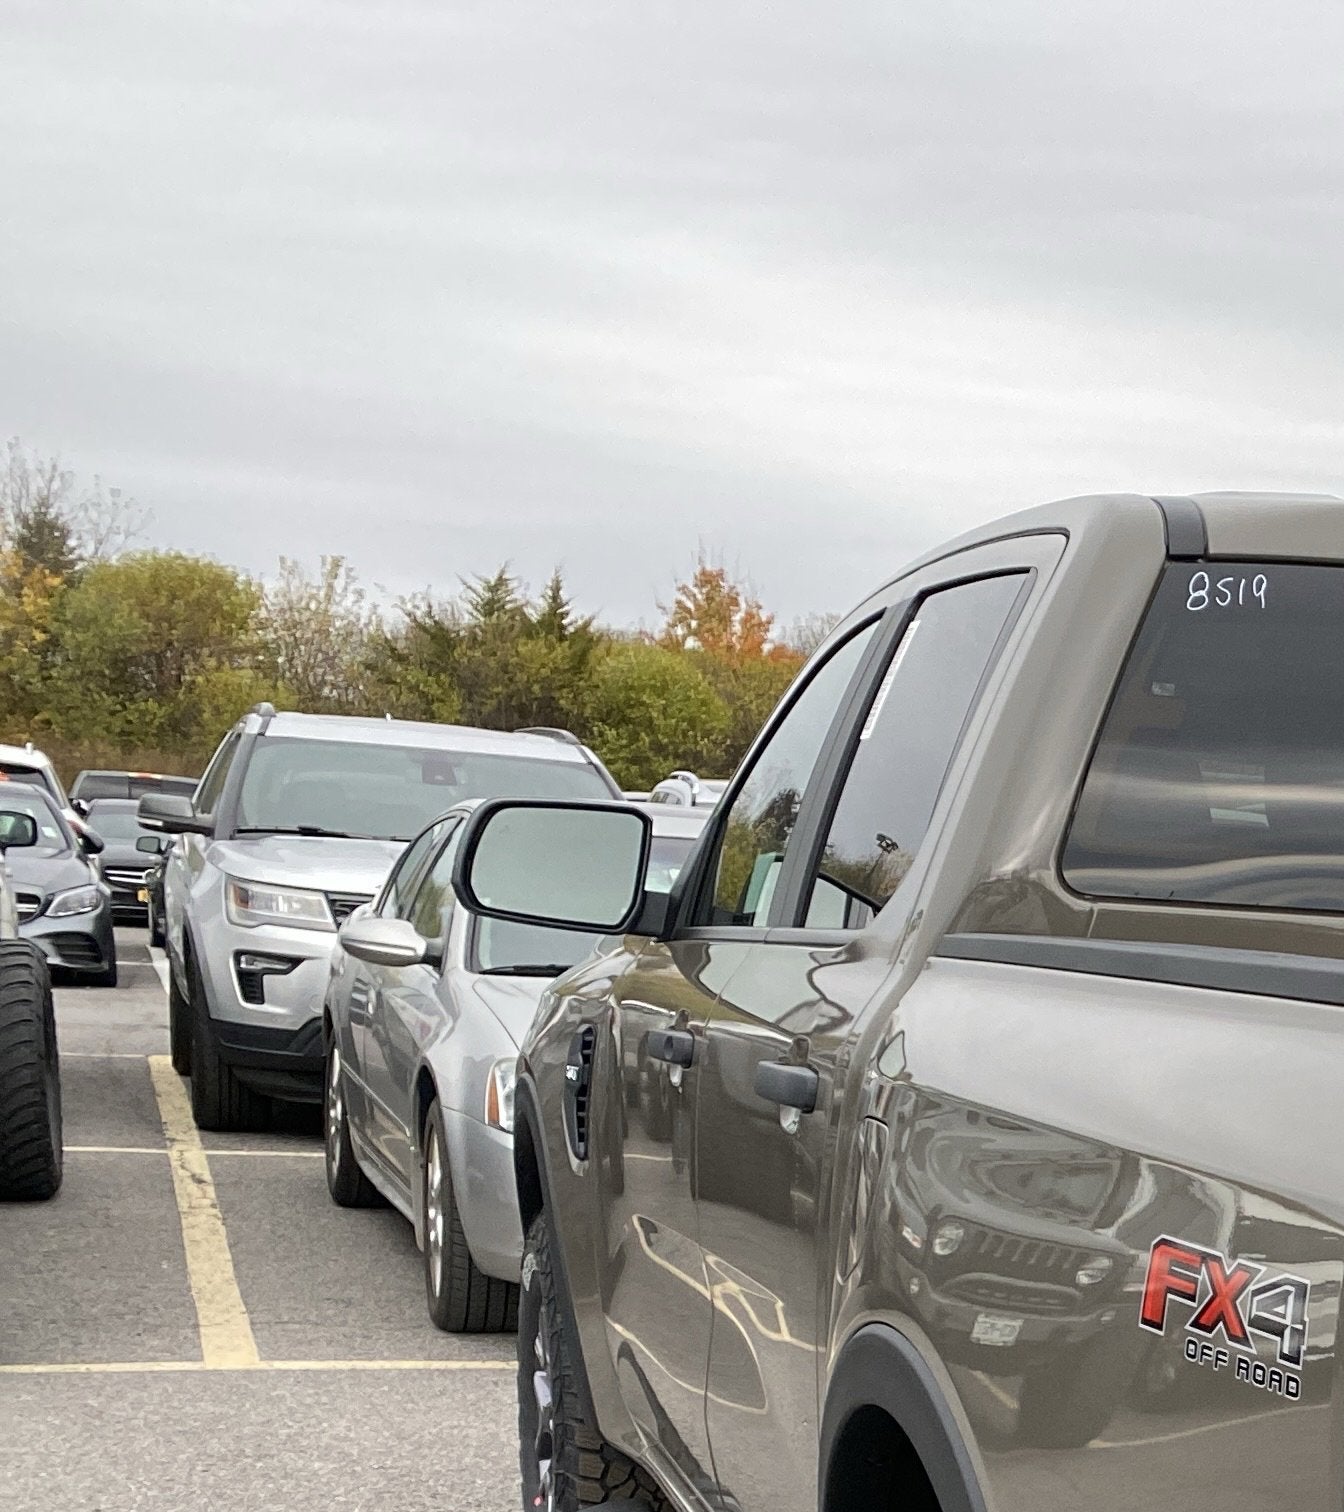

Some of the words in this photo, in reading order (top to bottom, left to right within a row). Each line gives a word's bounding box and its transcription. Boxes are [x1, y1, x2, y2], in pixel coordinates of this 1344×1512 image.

[1186, 571, 1267, 610] 8519
[1138, 1234, 1311, 1370] FX4
[1184, 1337, 1229, 1372] OFF
[1235, 1353, 1302, 1401] ROAD
